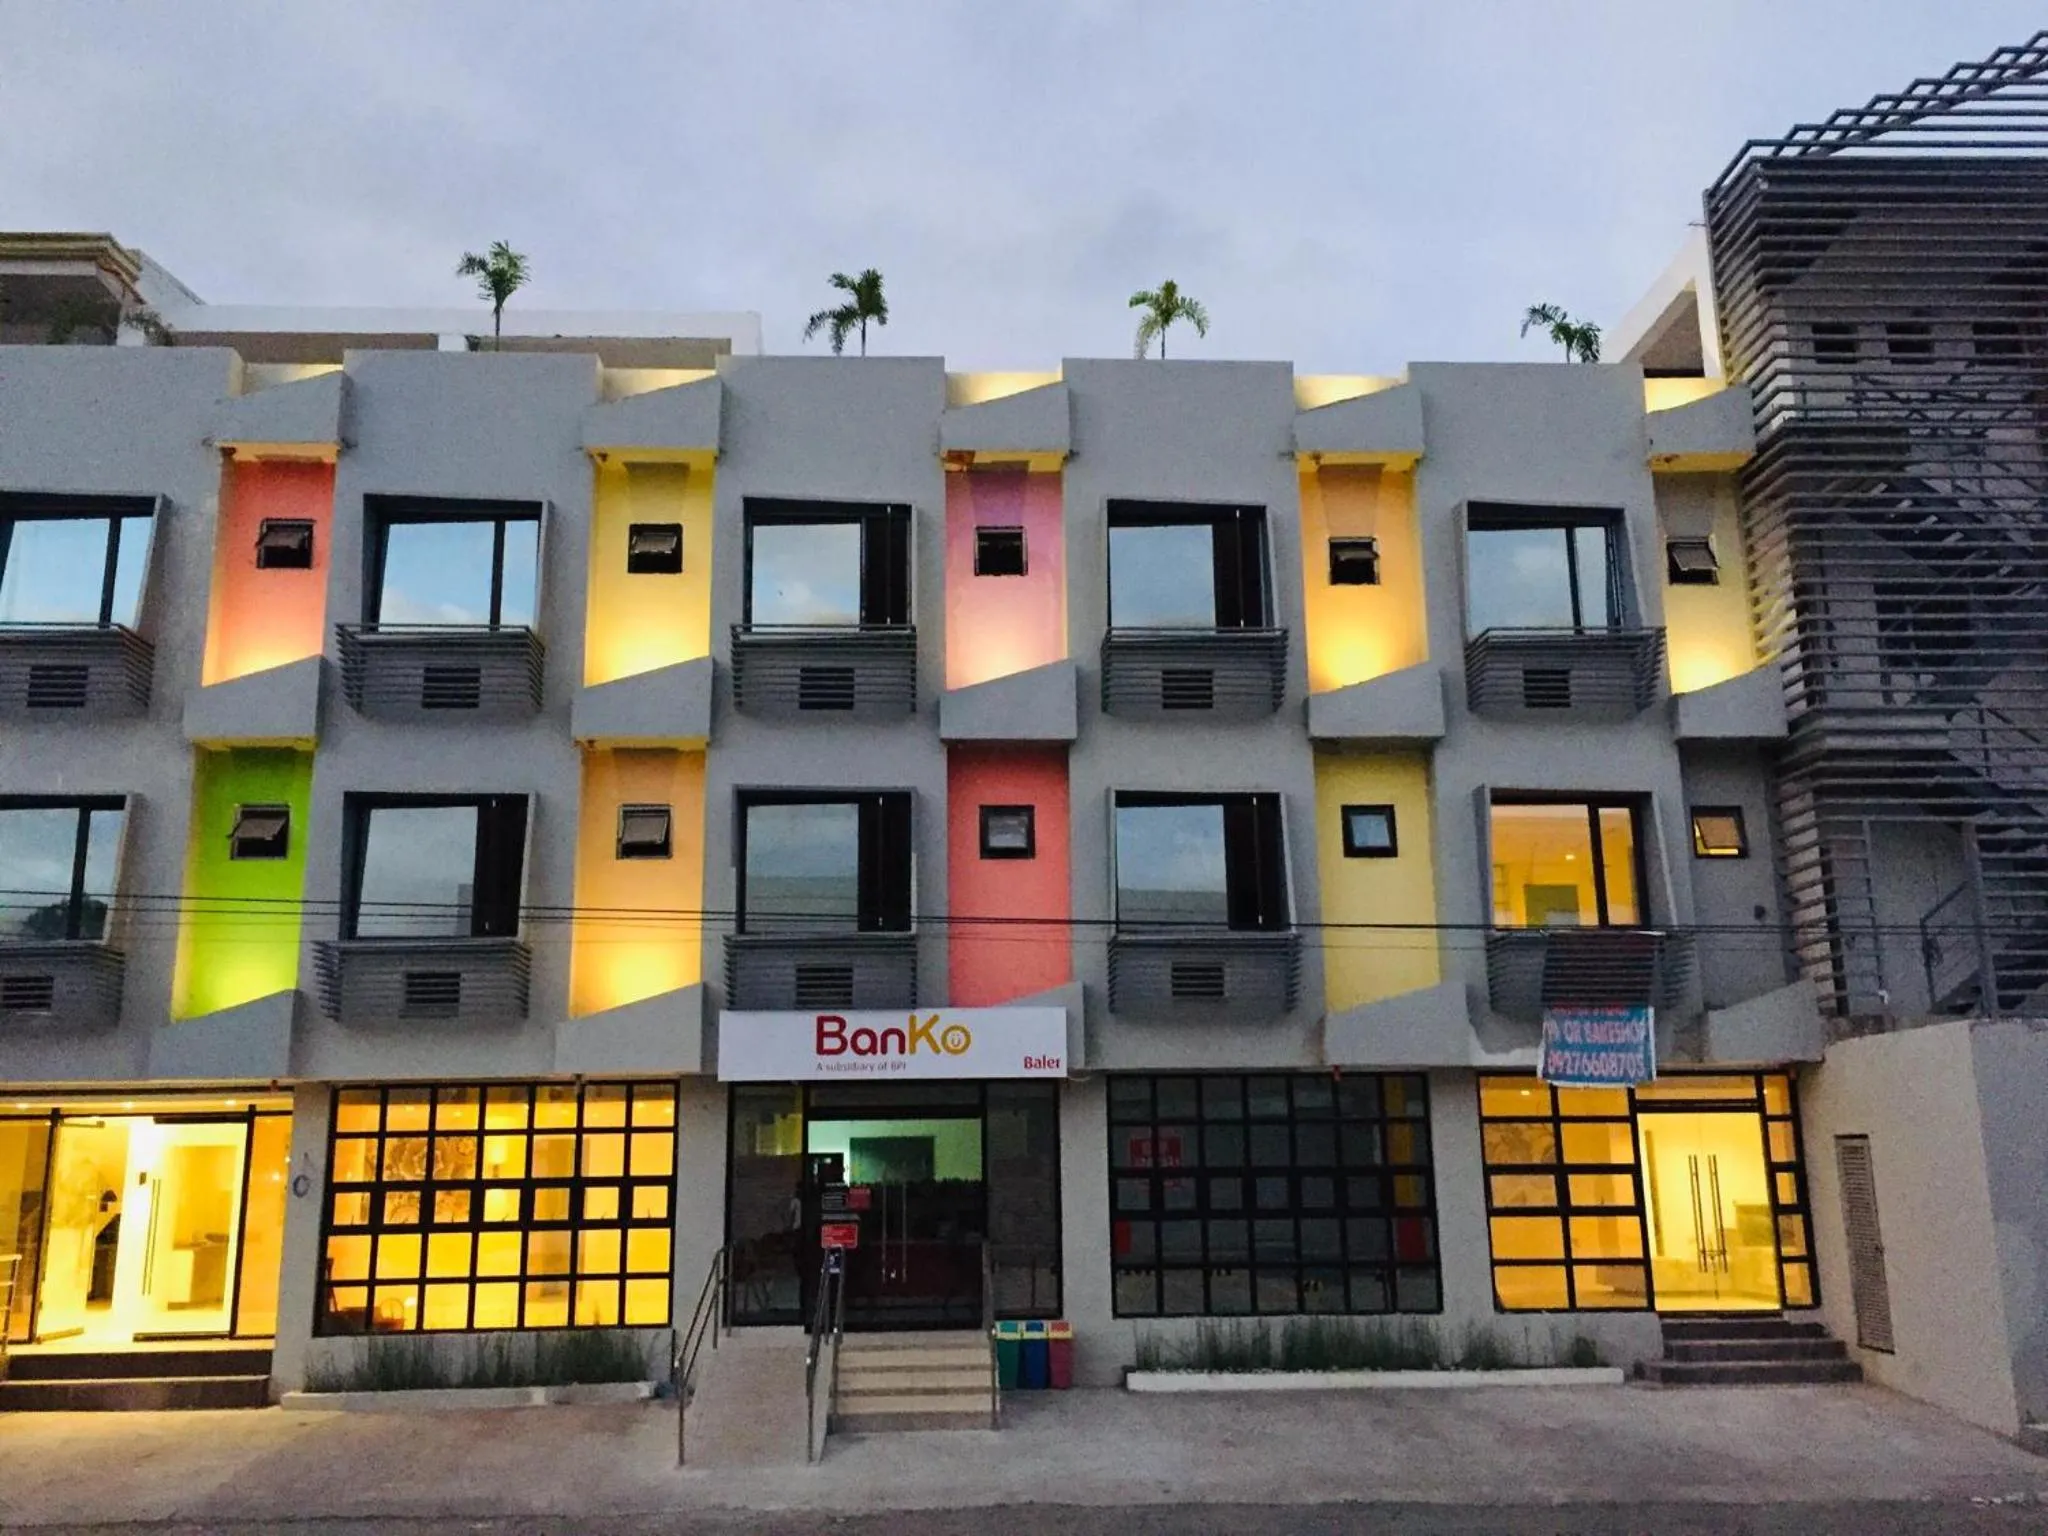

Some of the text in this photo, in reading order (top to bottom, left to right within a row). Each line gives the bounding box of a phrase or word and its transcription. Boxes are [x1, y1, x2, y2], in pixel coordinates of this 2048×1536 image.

[816, 1014, 971, 1056] BanKo
[816, 1062, 823, 1072] A
[825, 1061, 875, 1073] subsidiary
[878, 1061, 888, 1072] of
[1023, 1055, 1061, 1070] Baler
